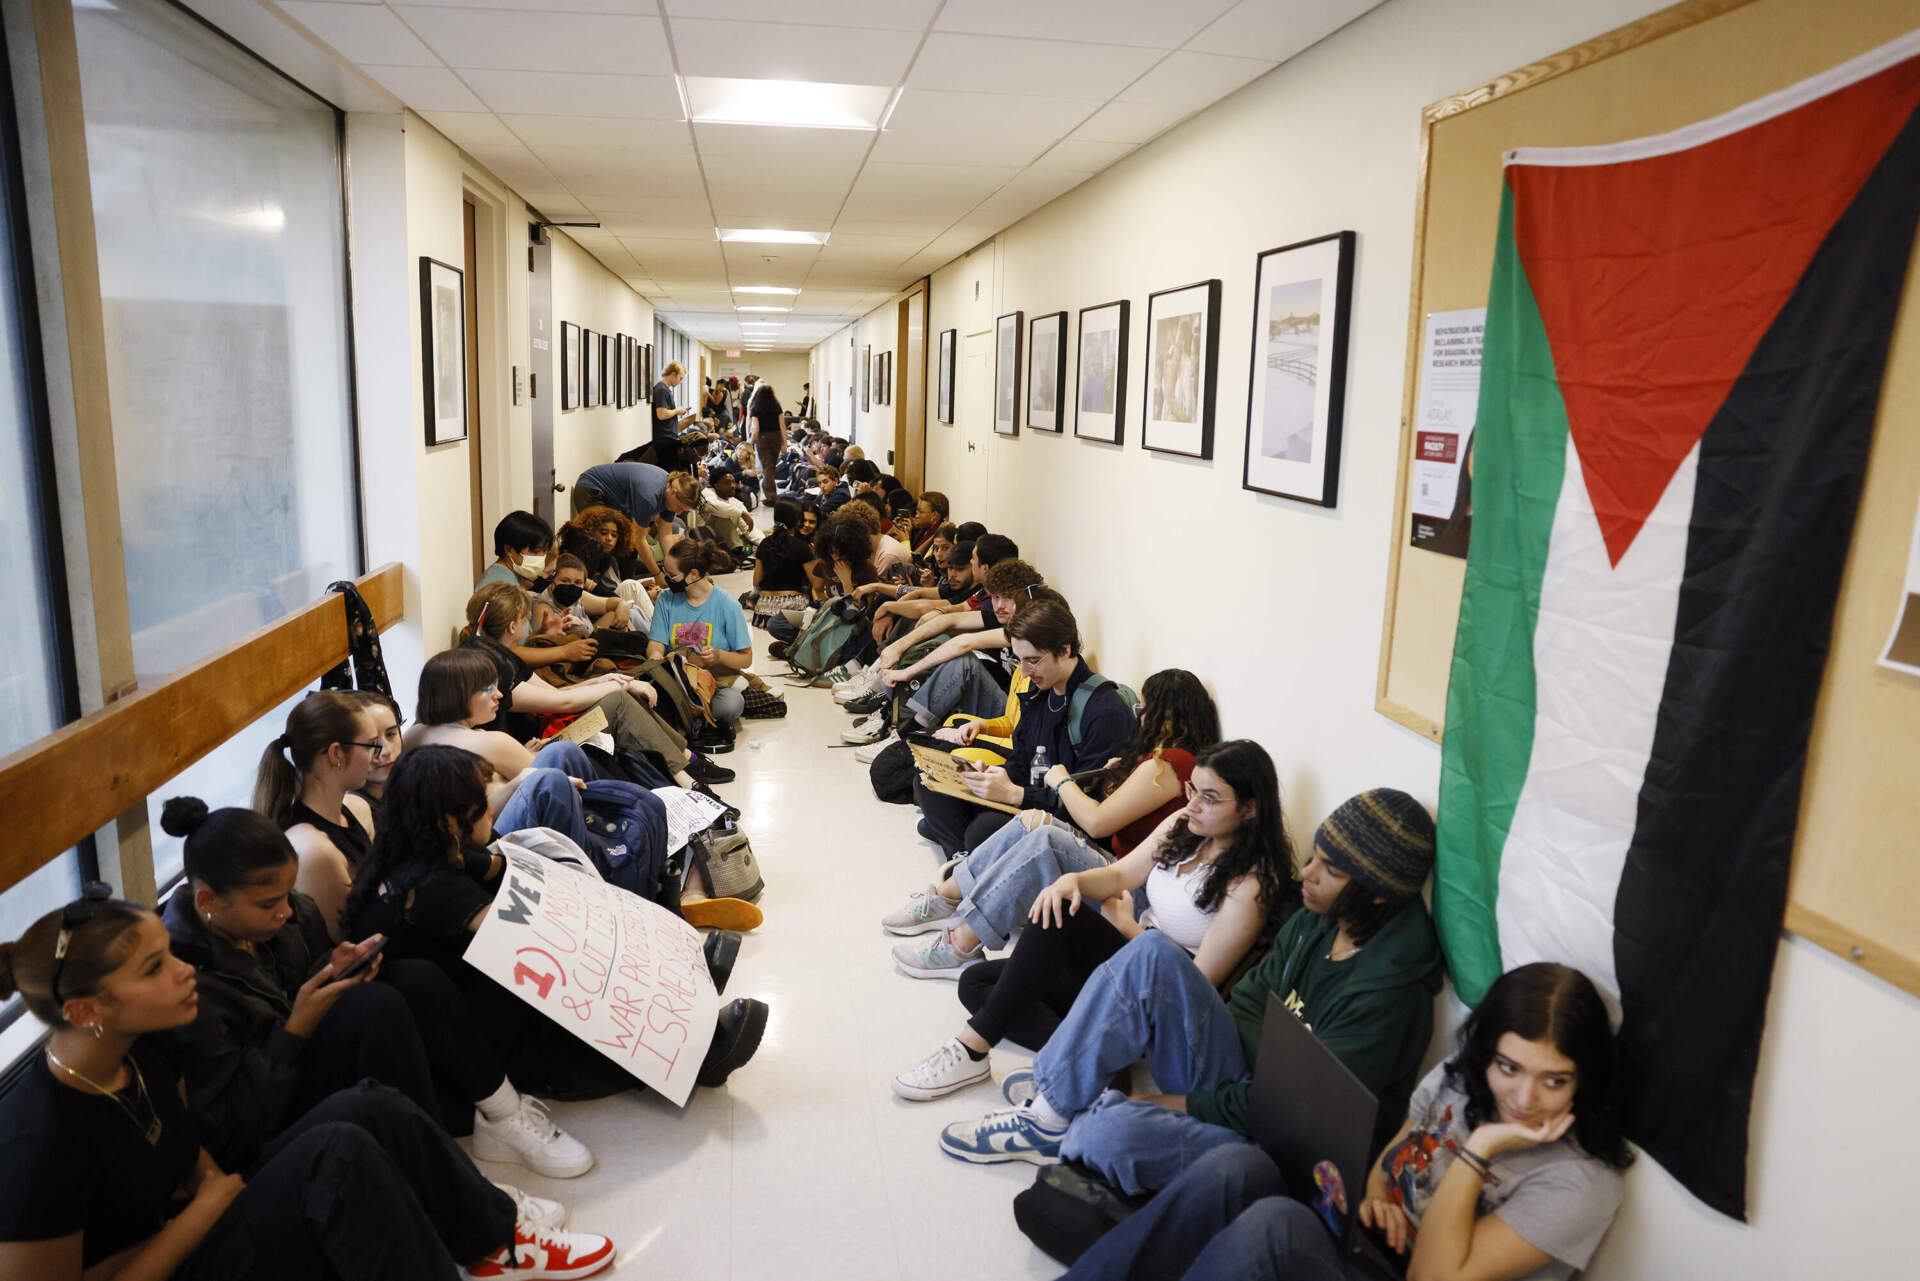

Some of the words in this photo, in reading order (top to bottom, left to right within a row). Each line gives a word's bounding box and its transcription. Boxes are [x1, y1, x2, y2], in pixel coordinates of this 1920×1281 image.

[1471, 325, 1483, 333] AND
[497, 874, 541, 926] WE
[572, 936, 613, 995] CUT
[560, 994, 594, 1022] &
[594, 985, 645, 1051] WAR
